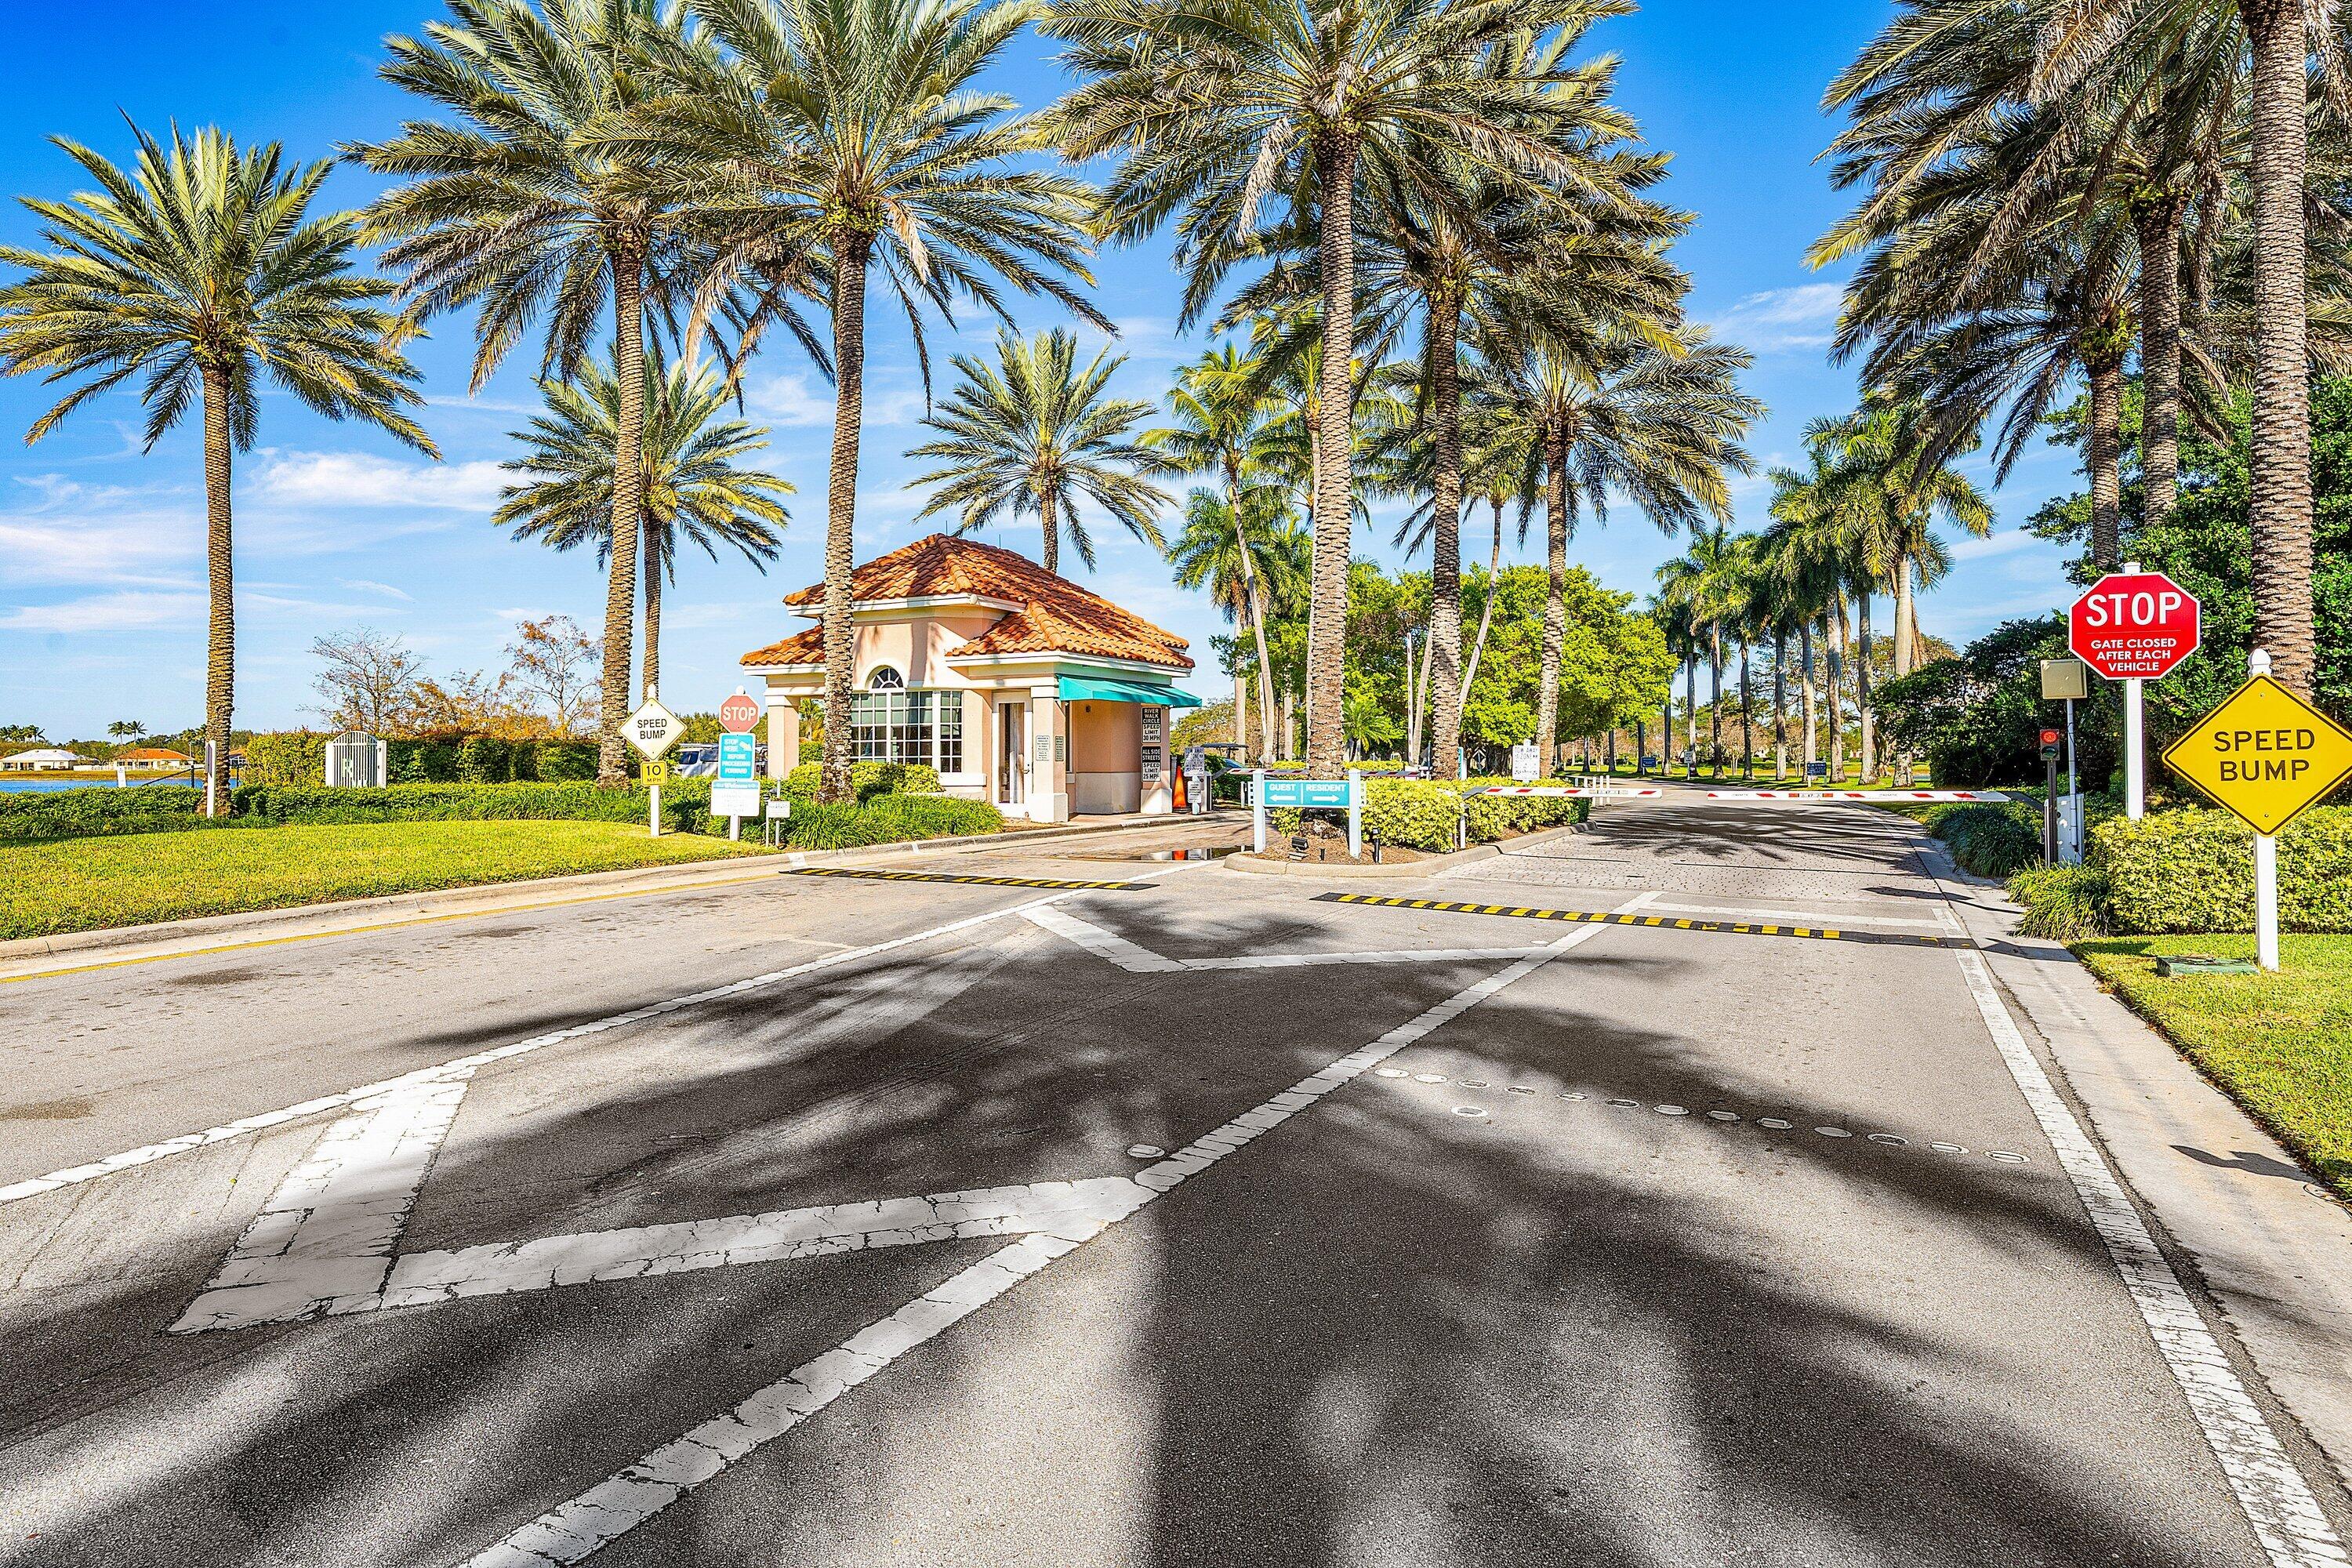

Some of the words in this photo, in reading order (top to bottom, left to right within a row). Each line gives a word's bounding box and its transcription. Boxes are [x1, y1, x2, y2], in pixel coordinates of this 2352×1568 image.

[2085, 591, 2182, 627] STOP
[2091, 638, 2123, 650] GATE
[2126, 637, 2177, 649] CLOSED
[2096, 650, 2132, 661] AFTER
[2135, 649, 2171, 660] EACH
[2107, 661, 2159, 672] VEHICLE
[723, 706, 757, 722] STOP
[637, 718, 667, 728] SPEED
[640, 730, 666, 739] BUMP
[2213, 728, 2315, 753] SPEED
[646, 764, 661, 775] 10
[2220, 759, 2310, 782] BUMP
